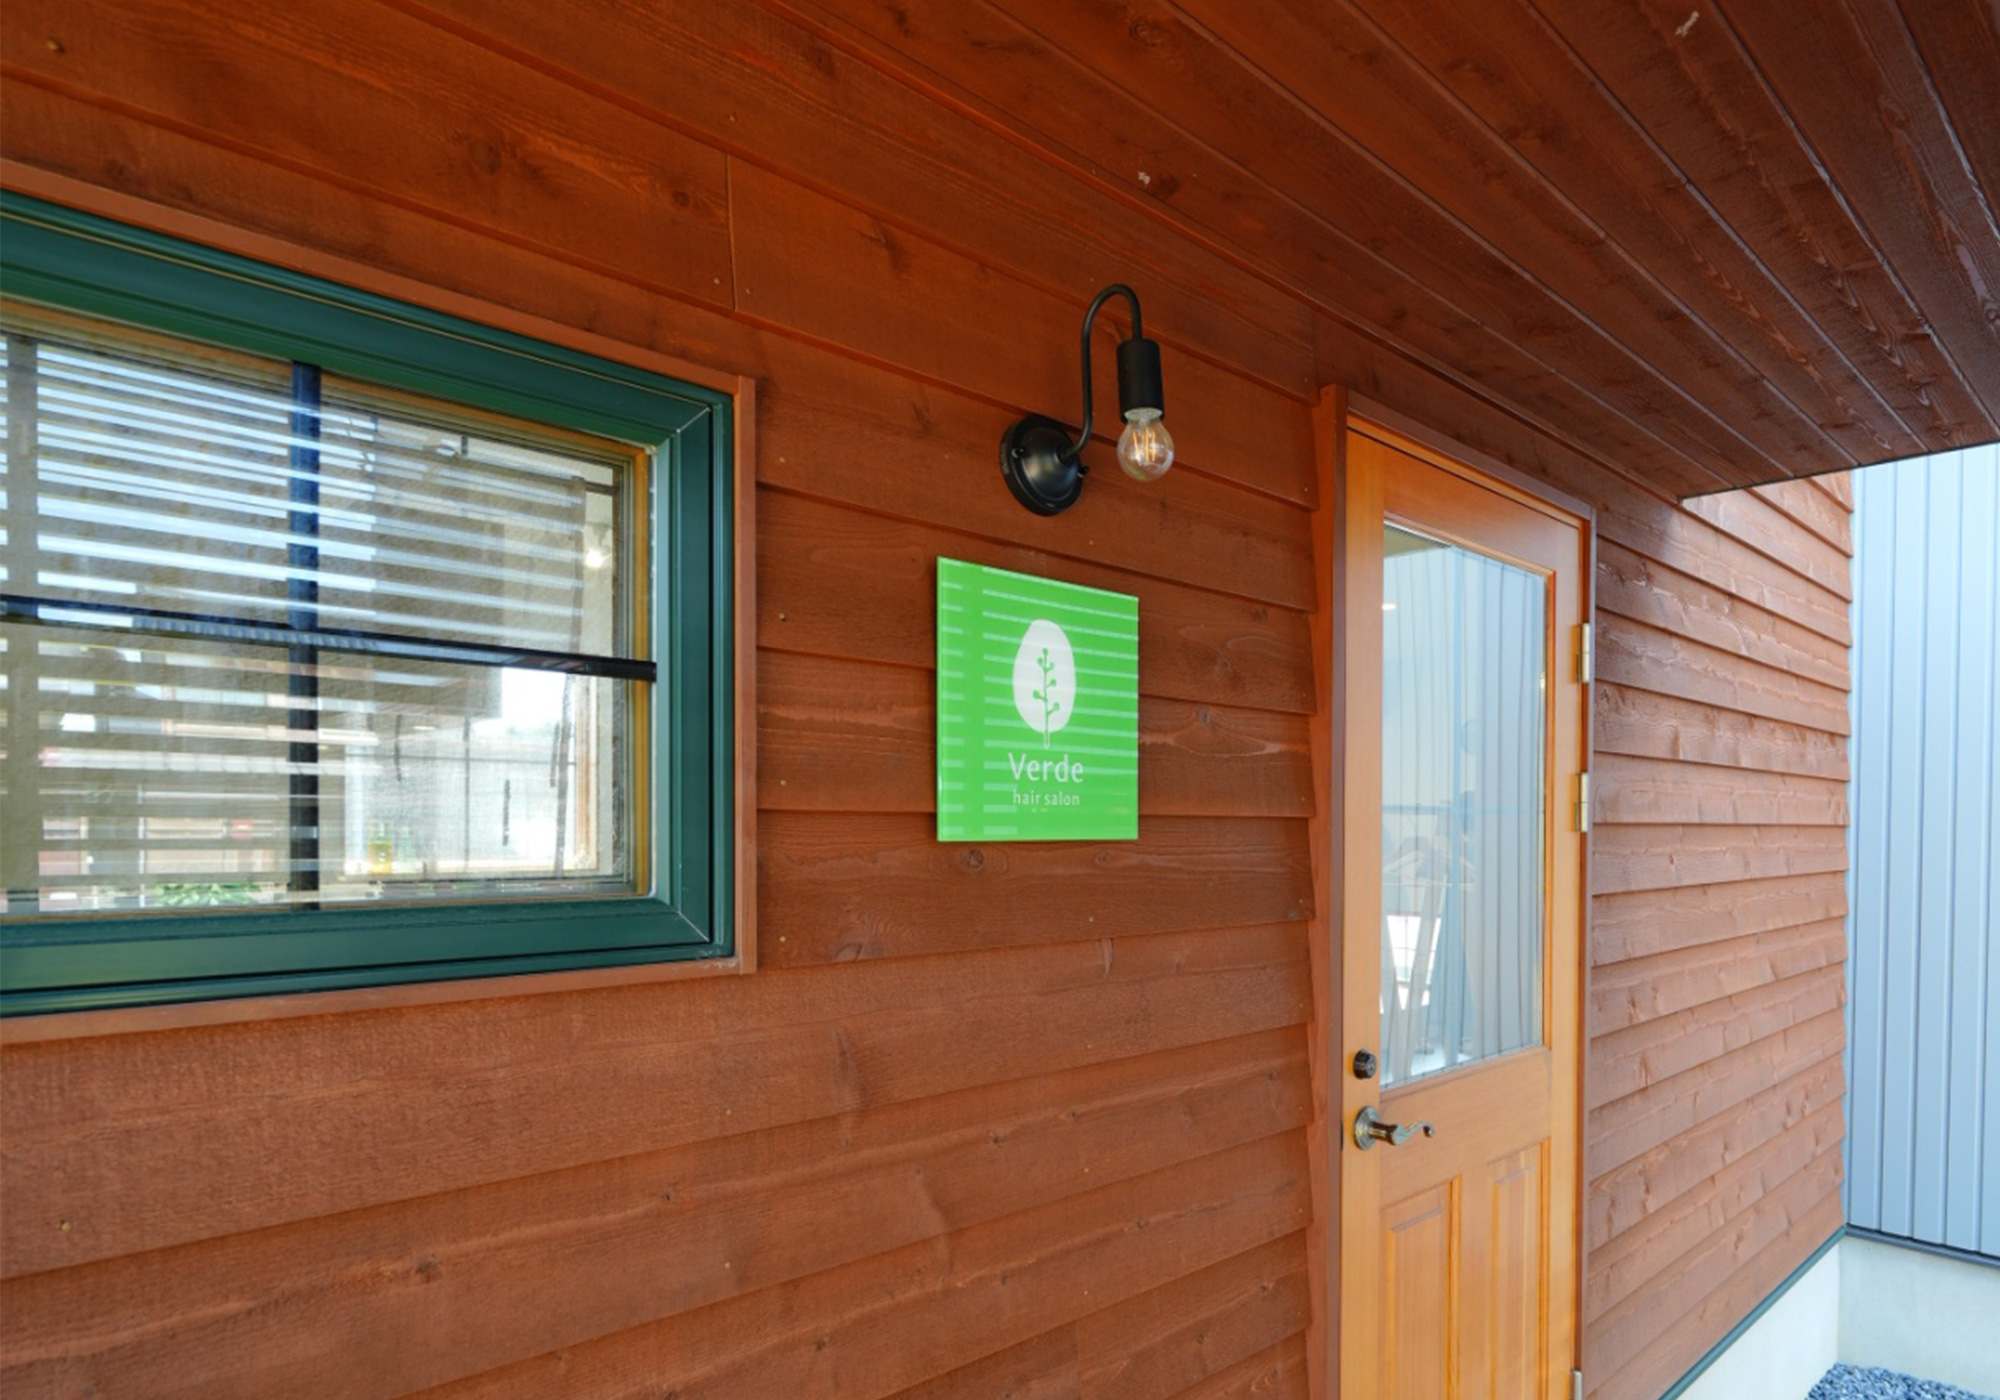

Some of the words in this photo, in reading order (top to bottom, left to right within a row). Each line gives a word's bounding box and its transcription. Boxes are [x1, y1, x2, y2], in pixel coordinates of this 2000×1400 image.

[1007, 752, 1084, 783] Verde
[1013, 789, 1041, 805] hair
[1044, 791, 1080, 806] salon
